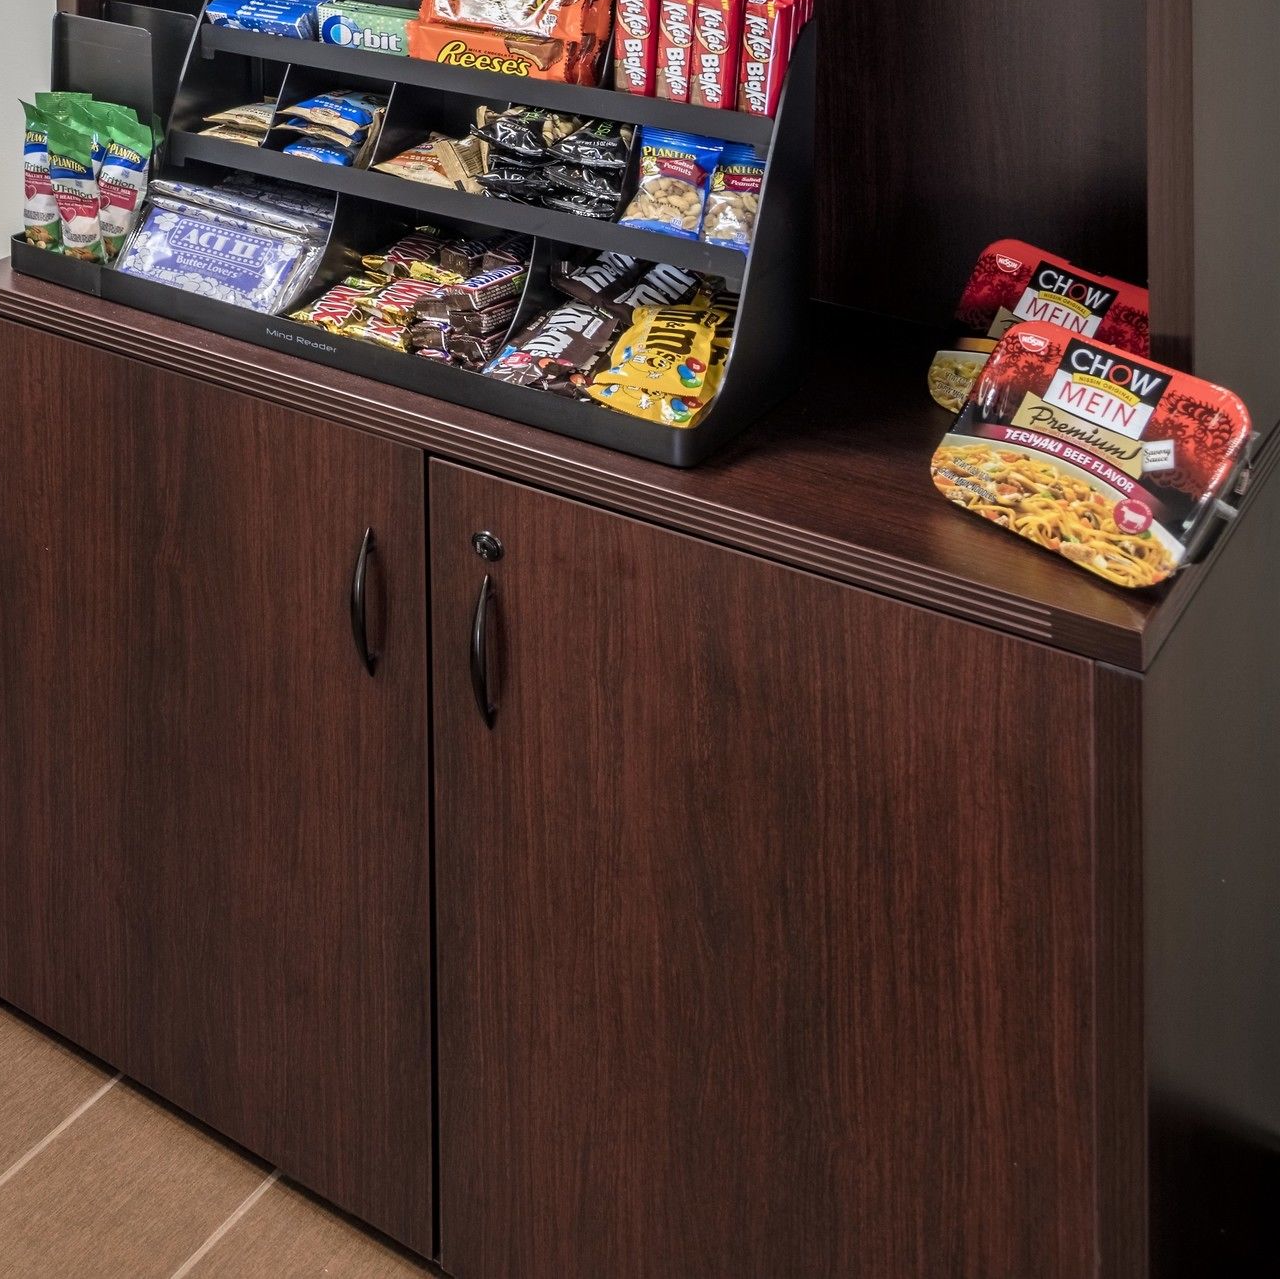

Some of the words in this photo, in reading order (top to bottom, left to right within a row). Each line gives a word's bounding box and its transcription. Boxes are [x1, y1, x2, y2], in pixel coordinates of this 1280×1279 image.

[323, 16, 402, 52] Orbit
[437, 40, 532, 77] Reese's
[52, 154, 87, 174] PLANTERS
[111, 143, 141, 164] PLANTERS
[642, 145, 697, 161] PLANTERS
[663, 162, 692, 177] Peanuts
[730, 179, 760, 188] Peanuts
[181, 228, 230, 251] ACT
[228, 239, 261, 260] II
[175, 254, 206, 270] Butter
[206, 261, 239, 279] Lovers
[1038, 269, 1111, 310] CHOW
[1025, 296, 1090, 335] MEIN
[265, 327, 294, 341] Mind
[296, 335, 337, 353] Reader
[1070, 347, 1163, 397] CHOW
[1078, 375, 1102, 387] NISSIN
[1058, 380, 1137, 428] MEIN
[1028, 406, 1142, 461] Premium
[1004, 428, 1064, 454] TERIYAKI
[1062, 446, 1093, 467] BEEF
[1091, 462, 1136, 493] FLAVOR
